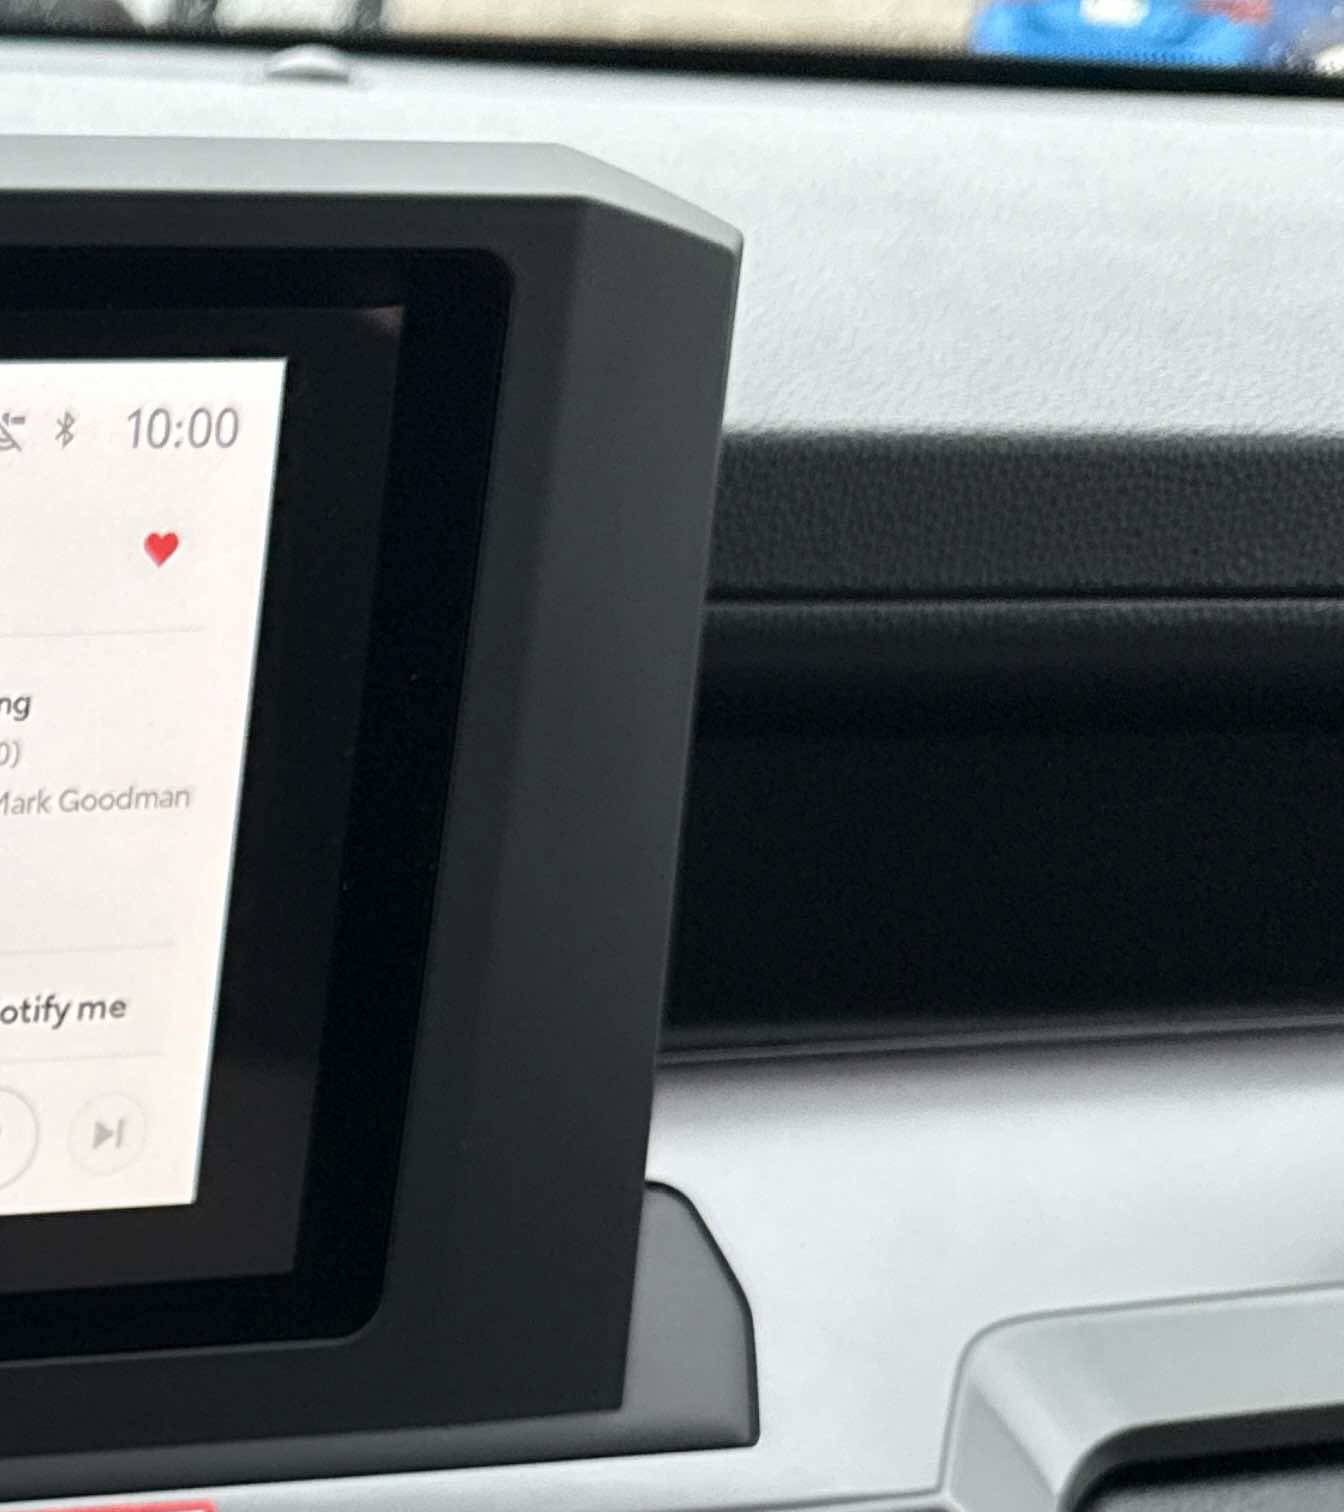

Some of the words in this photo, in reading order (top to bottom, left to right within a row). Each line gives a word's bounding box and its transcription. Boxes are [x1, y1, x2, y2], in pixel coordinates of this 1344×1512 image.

[126, 406, 239, 449] 10:00
[58, 785, 191, 814] Goodman
[77, 998, 127, 1020] me
